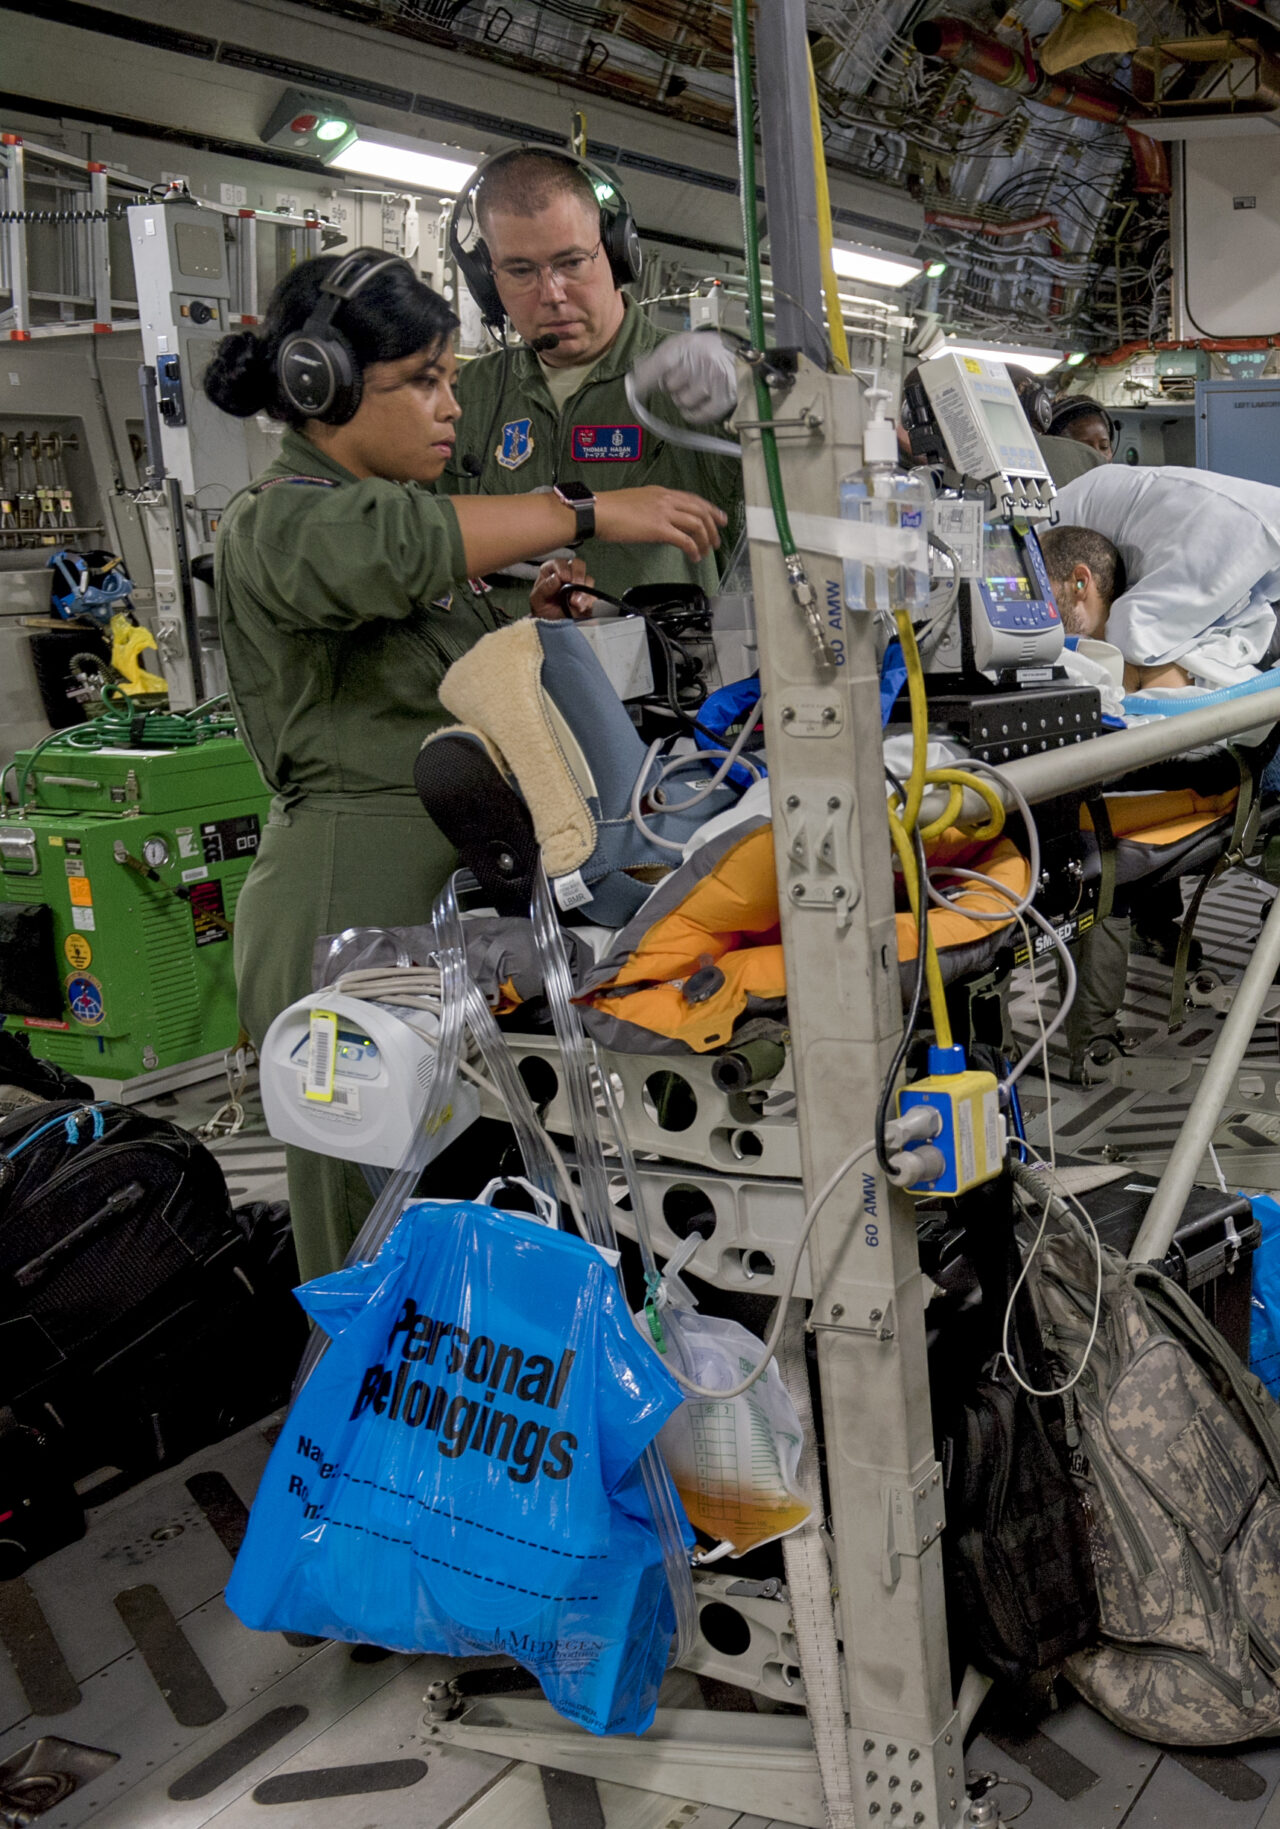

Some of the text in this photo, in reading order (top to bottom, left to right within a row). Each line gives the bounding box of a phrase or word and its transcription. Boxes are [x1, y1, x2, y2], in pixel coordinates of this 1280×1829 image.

[825, 579, 843, 631] AMW
[861, 1171, 879, 1248] 60 AMW
[387, 1297, 577, 1411] Personal
[349, 1359, 578, 1485] Belongings
